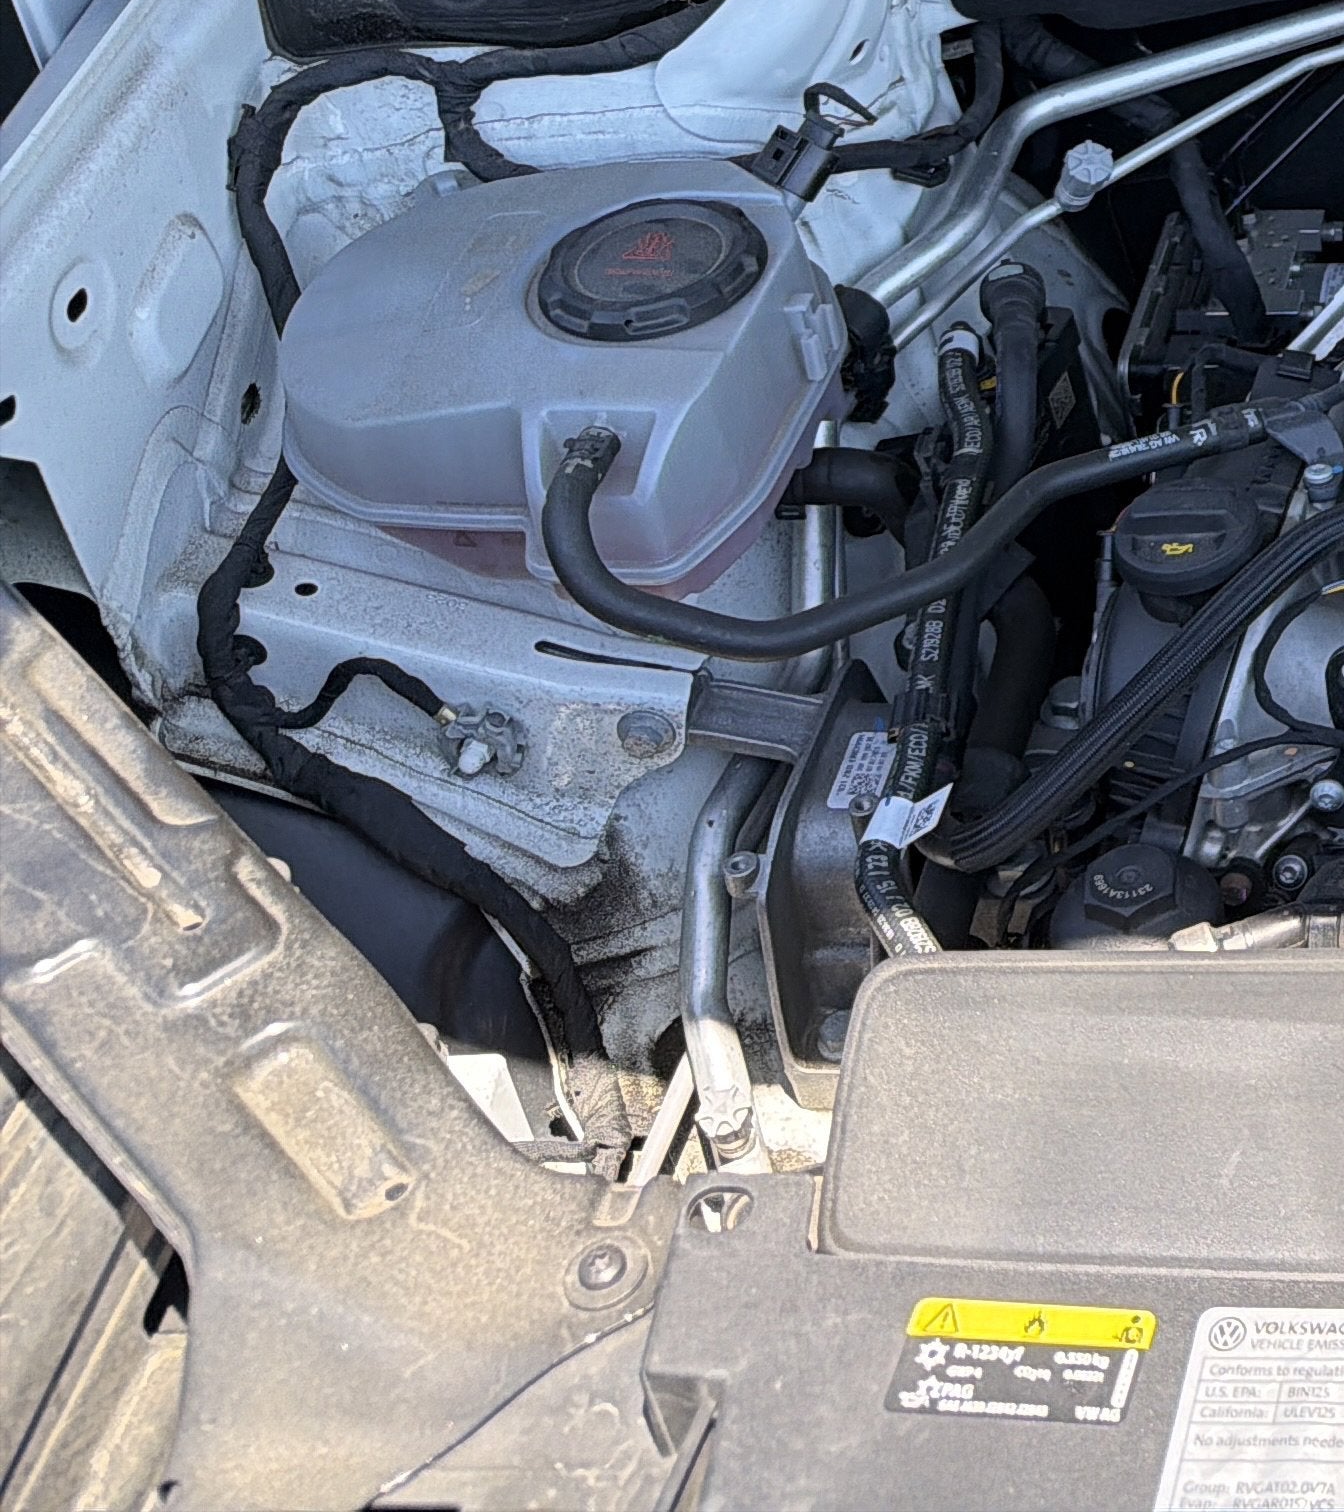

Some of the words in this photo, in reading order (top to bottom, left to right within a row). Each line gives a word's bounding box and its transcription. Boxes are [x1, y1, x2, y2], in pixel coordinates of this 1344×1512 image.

[1250, 1338, 1306, 1351] VEHICLE
[1209, 1363, 1273, 1377] Conforms
[1276, 1364, 1290, 1377] to
[1200, 1406, 1269, 1419] California:
[1193, 1434, 1213, 1447] No
[1216, 1434, 1300, 1450] adjustments
[1182, 1480, 1230, 1496] Group:
